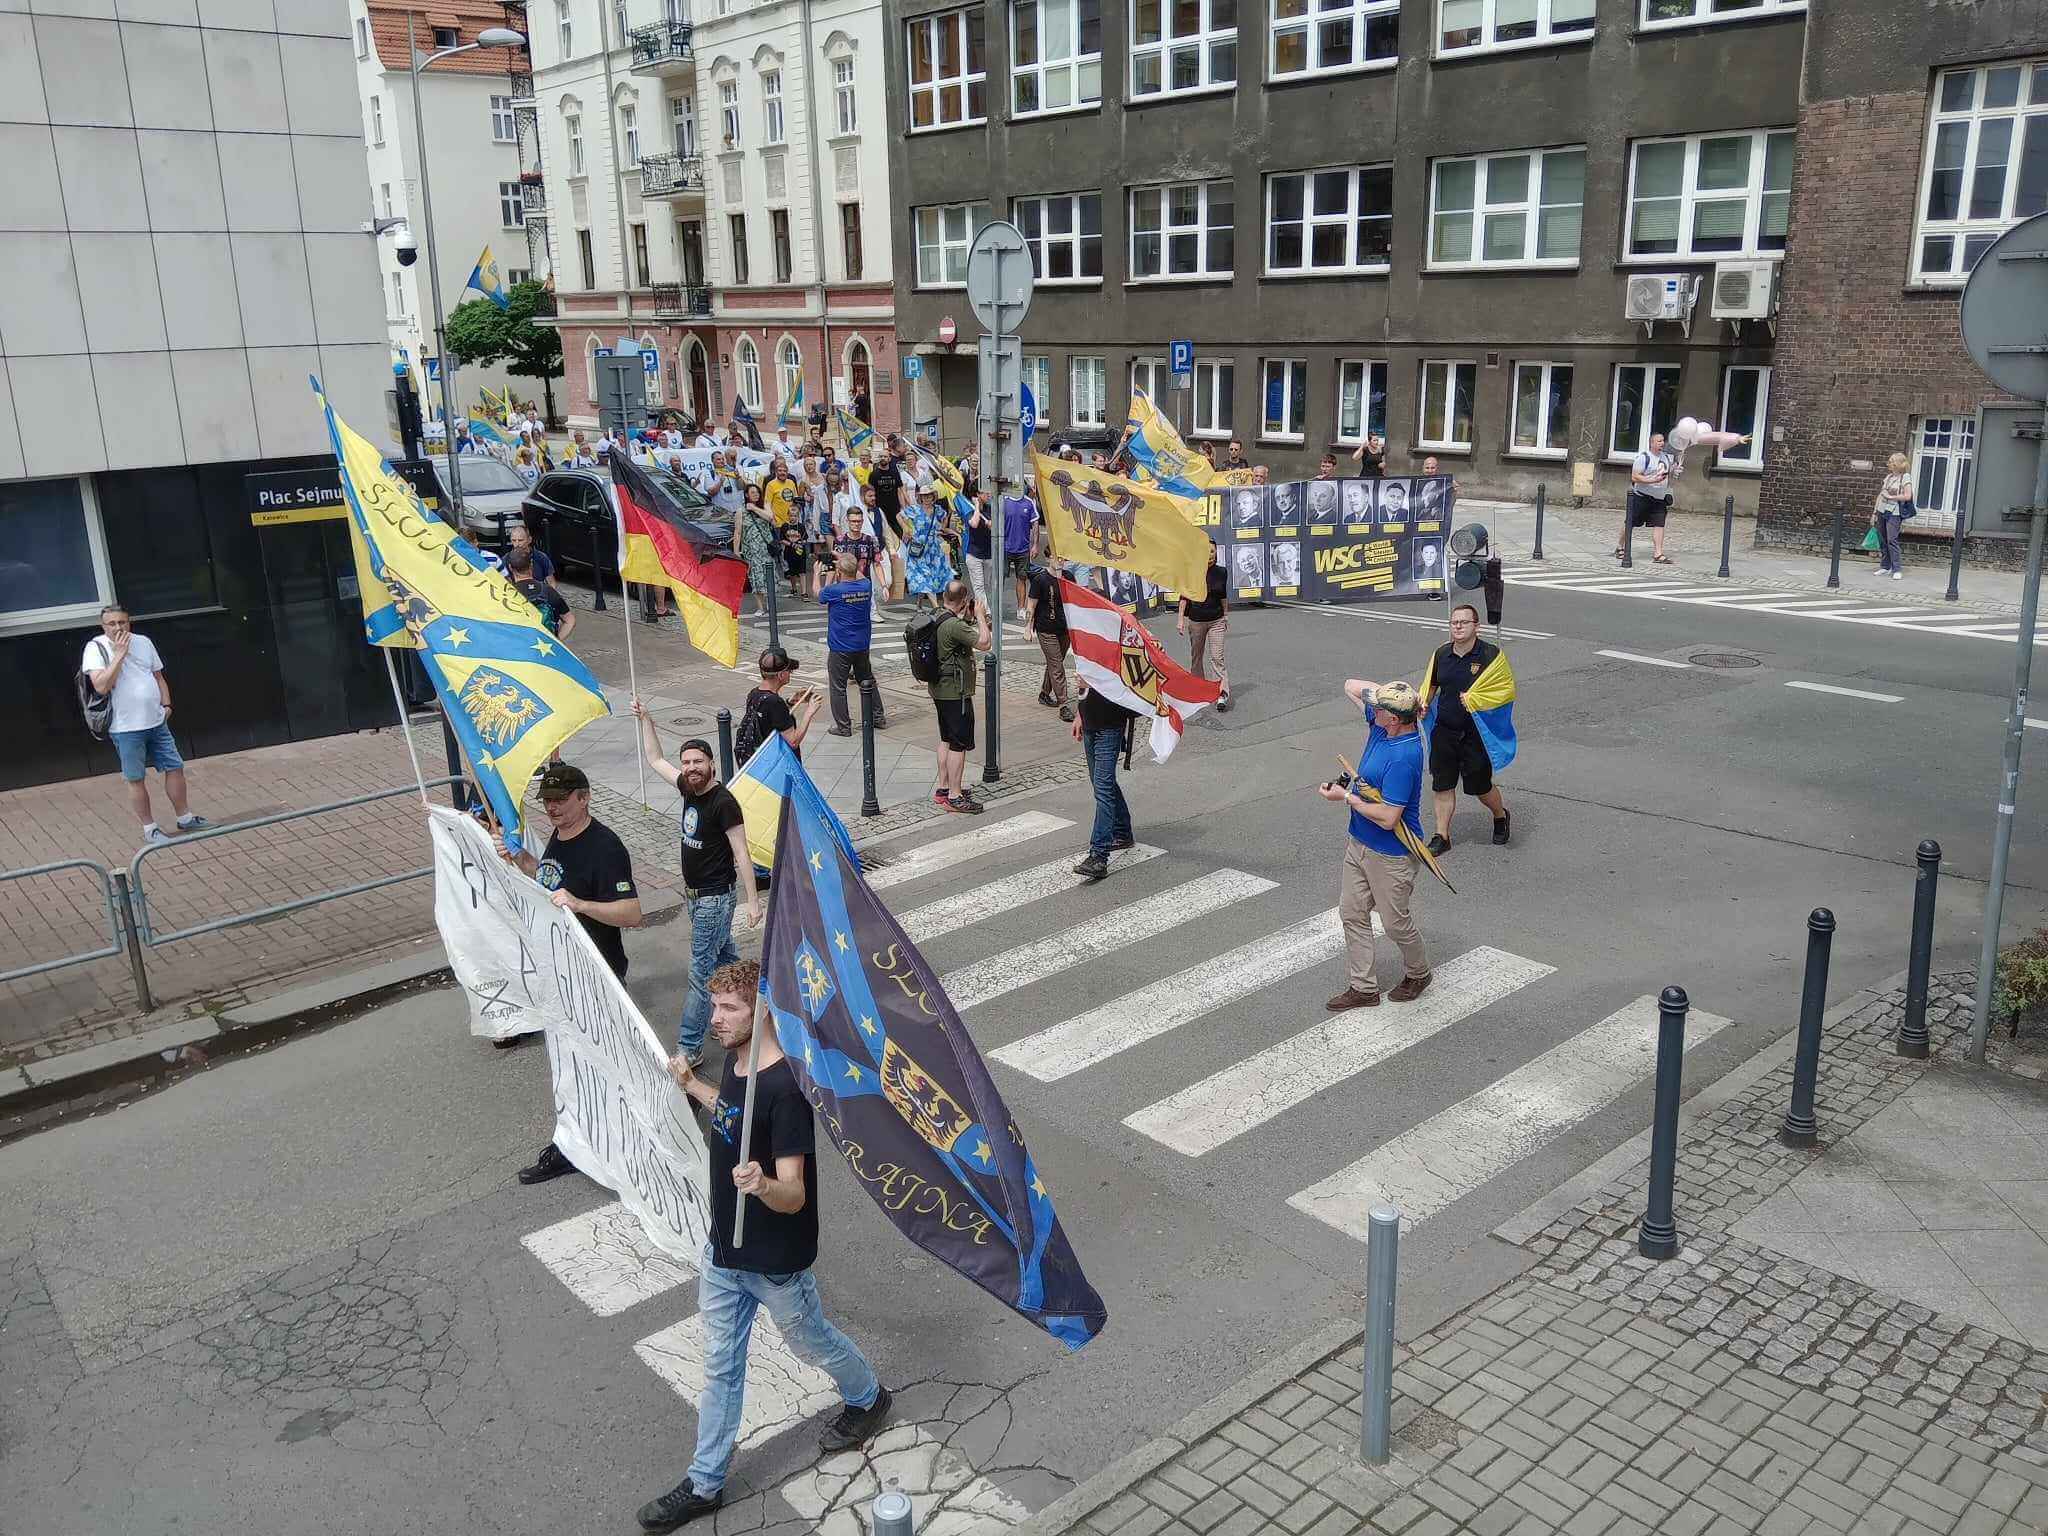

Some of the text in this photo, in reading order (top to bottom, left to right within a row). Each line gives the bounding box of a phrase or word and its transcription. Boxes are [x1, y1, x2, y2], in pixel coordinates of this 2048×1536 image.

[259, 486, 343, 506] Plac Sejmu
[1314, 543, 1364, 574] WSC
